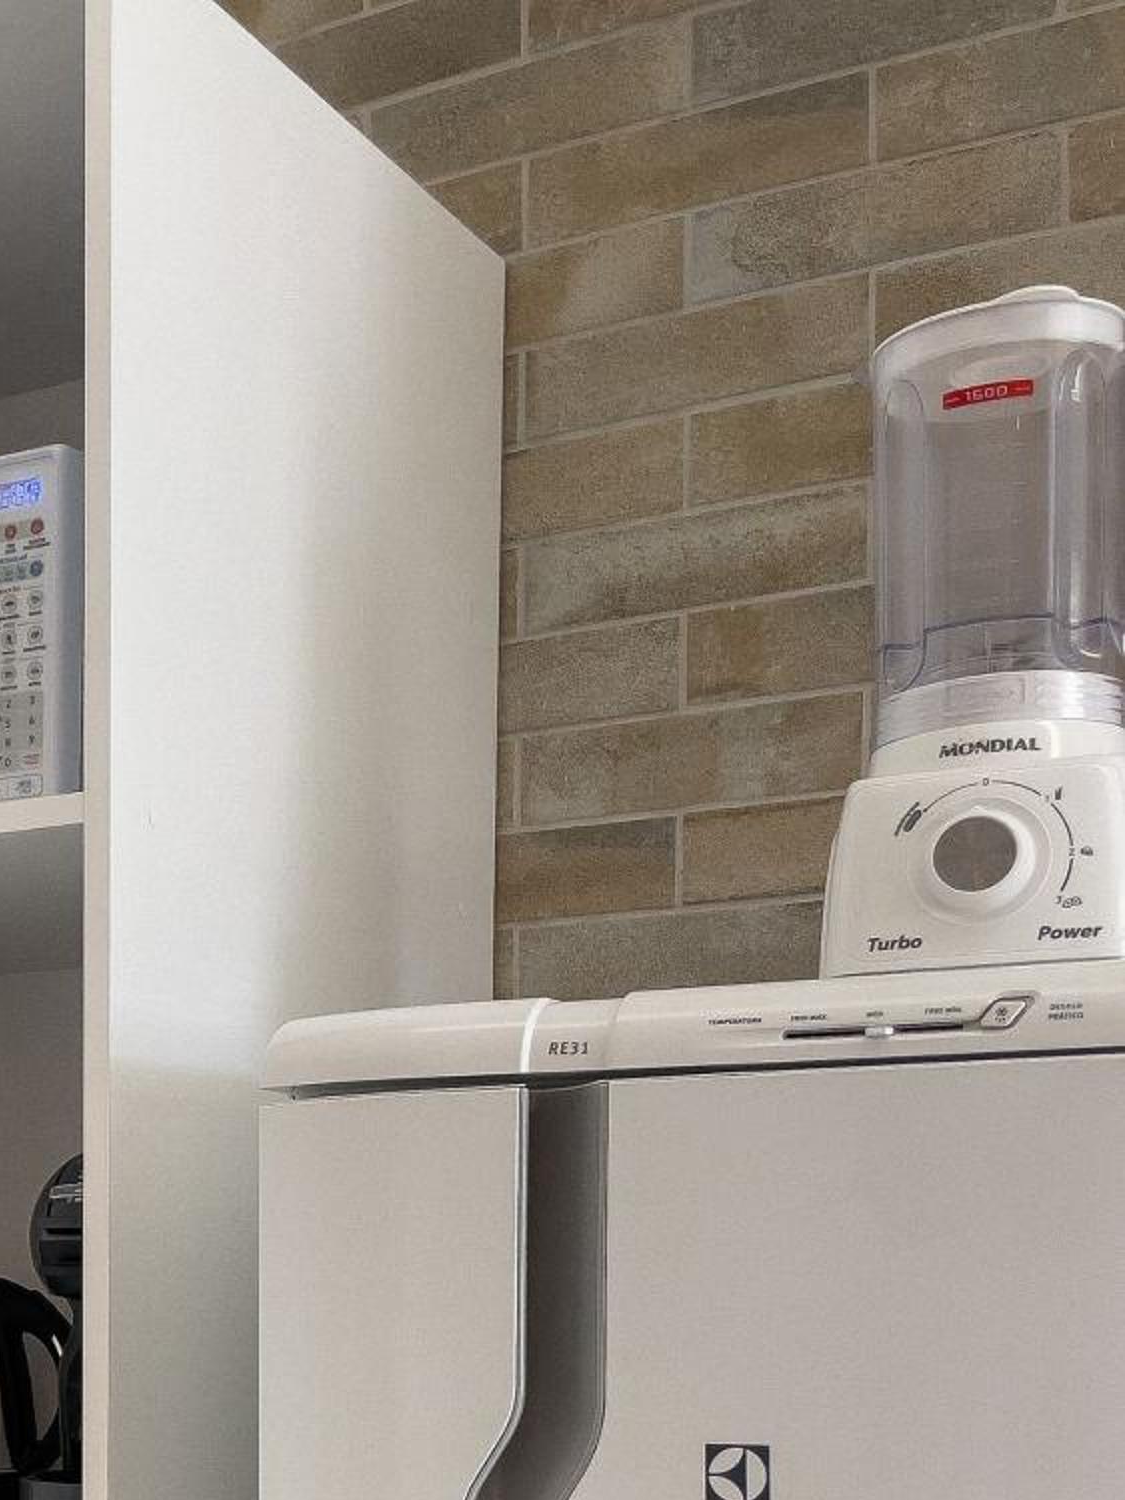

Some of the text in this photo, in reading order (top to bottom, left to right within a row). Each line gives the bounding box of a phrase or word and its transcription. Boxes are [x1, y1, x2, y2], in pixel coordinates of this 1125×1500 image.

[938, 737, 1043, 759] MONDIAL
[1037, 925, 1103, 941] Power
[867, 935, 923, 953] Turbo
[548, 1041, 588, 1055] RE31
